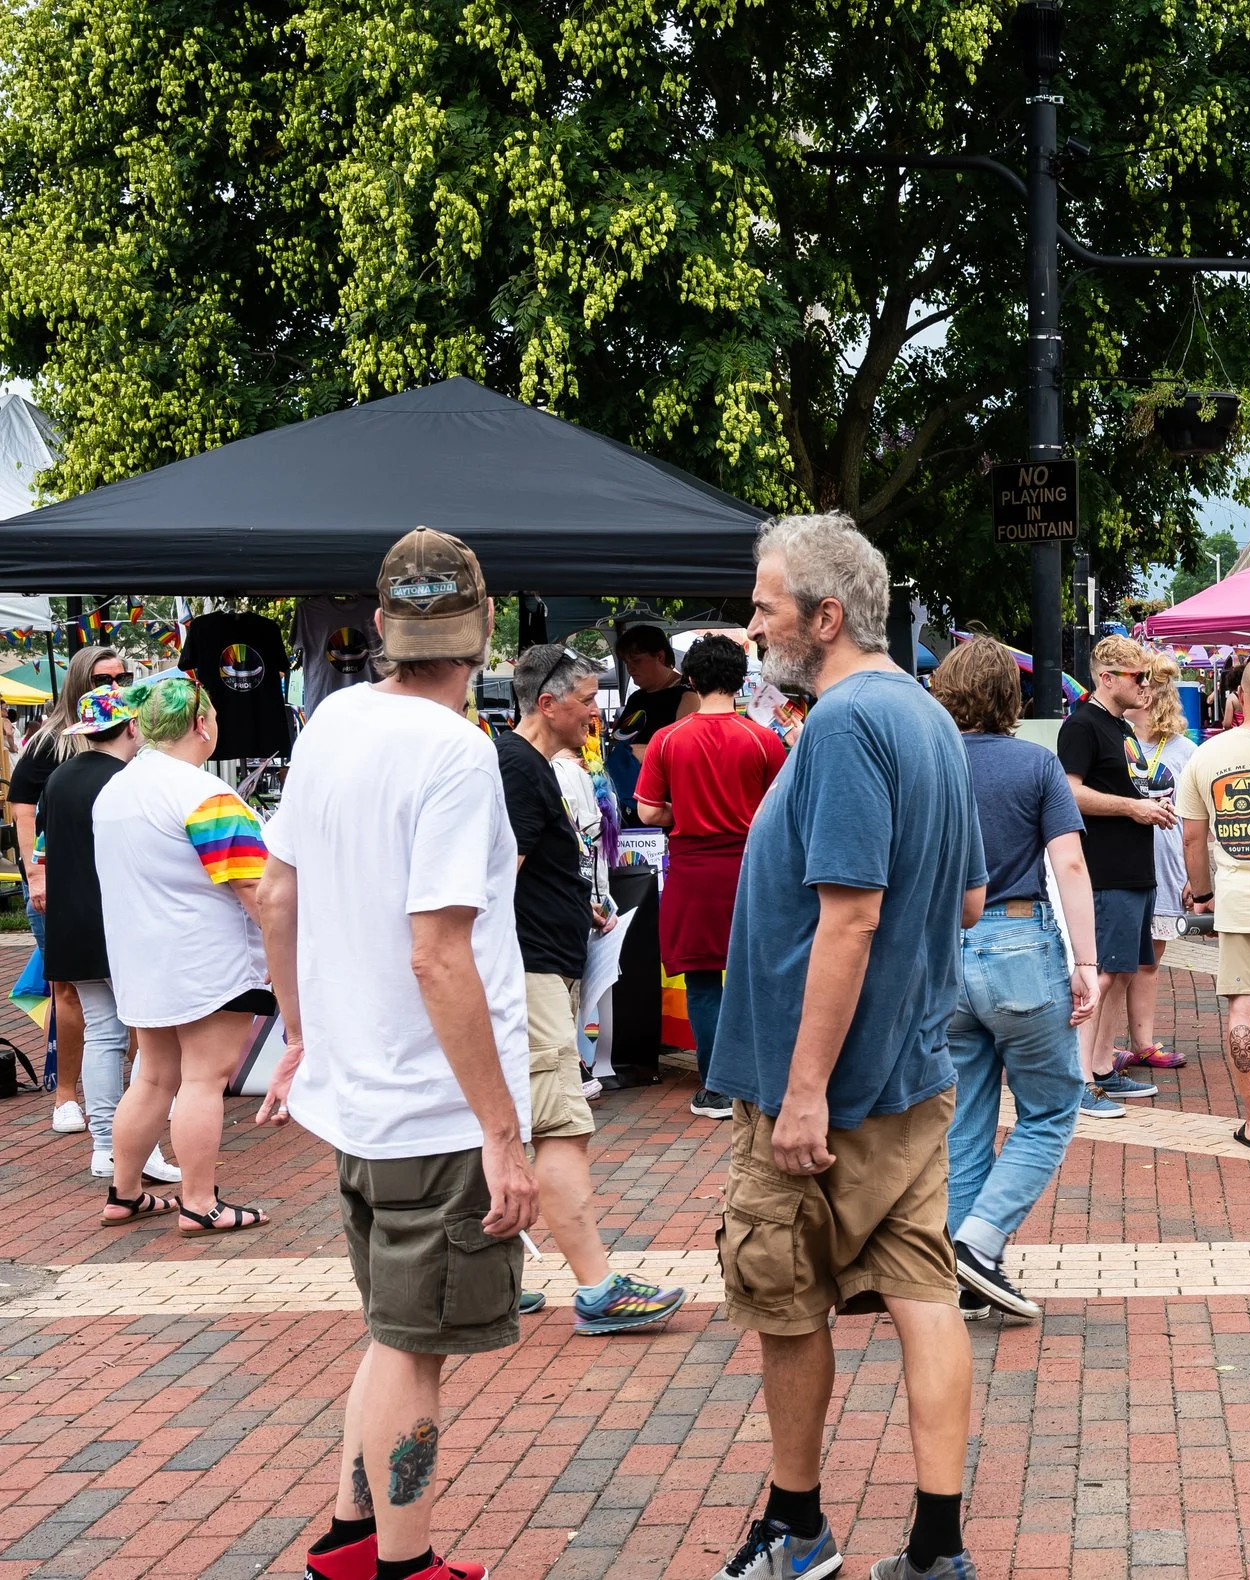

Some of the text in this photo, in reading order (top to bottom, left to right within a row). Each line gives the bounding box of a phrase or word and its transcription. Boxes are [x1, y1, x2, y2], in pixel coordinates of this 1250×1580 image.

[1018, 465, 1049, 487] NO
[1001, 486, 1067, 506] PLAYING
[1027, 505, 1041, 521] IN
[997, 520, 1073, 540] FOUNTAIN
[393, 583, 453, 596] DAYTONA 500
[1215, 767, 1231, 776] TAKE
[617, 839, 657, 848] ONATIONS
